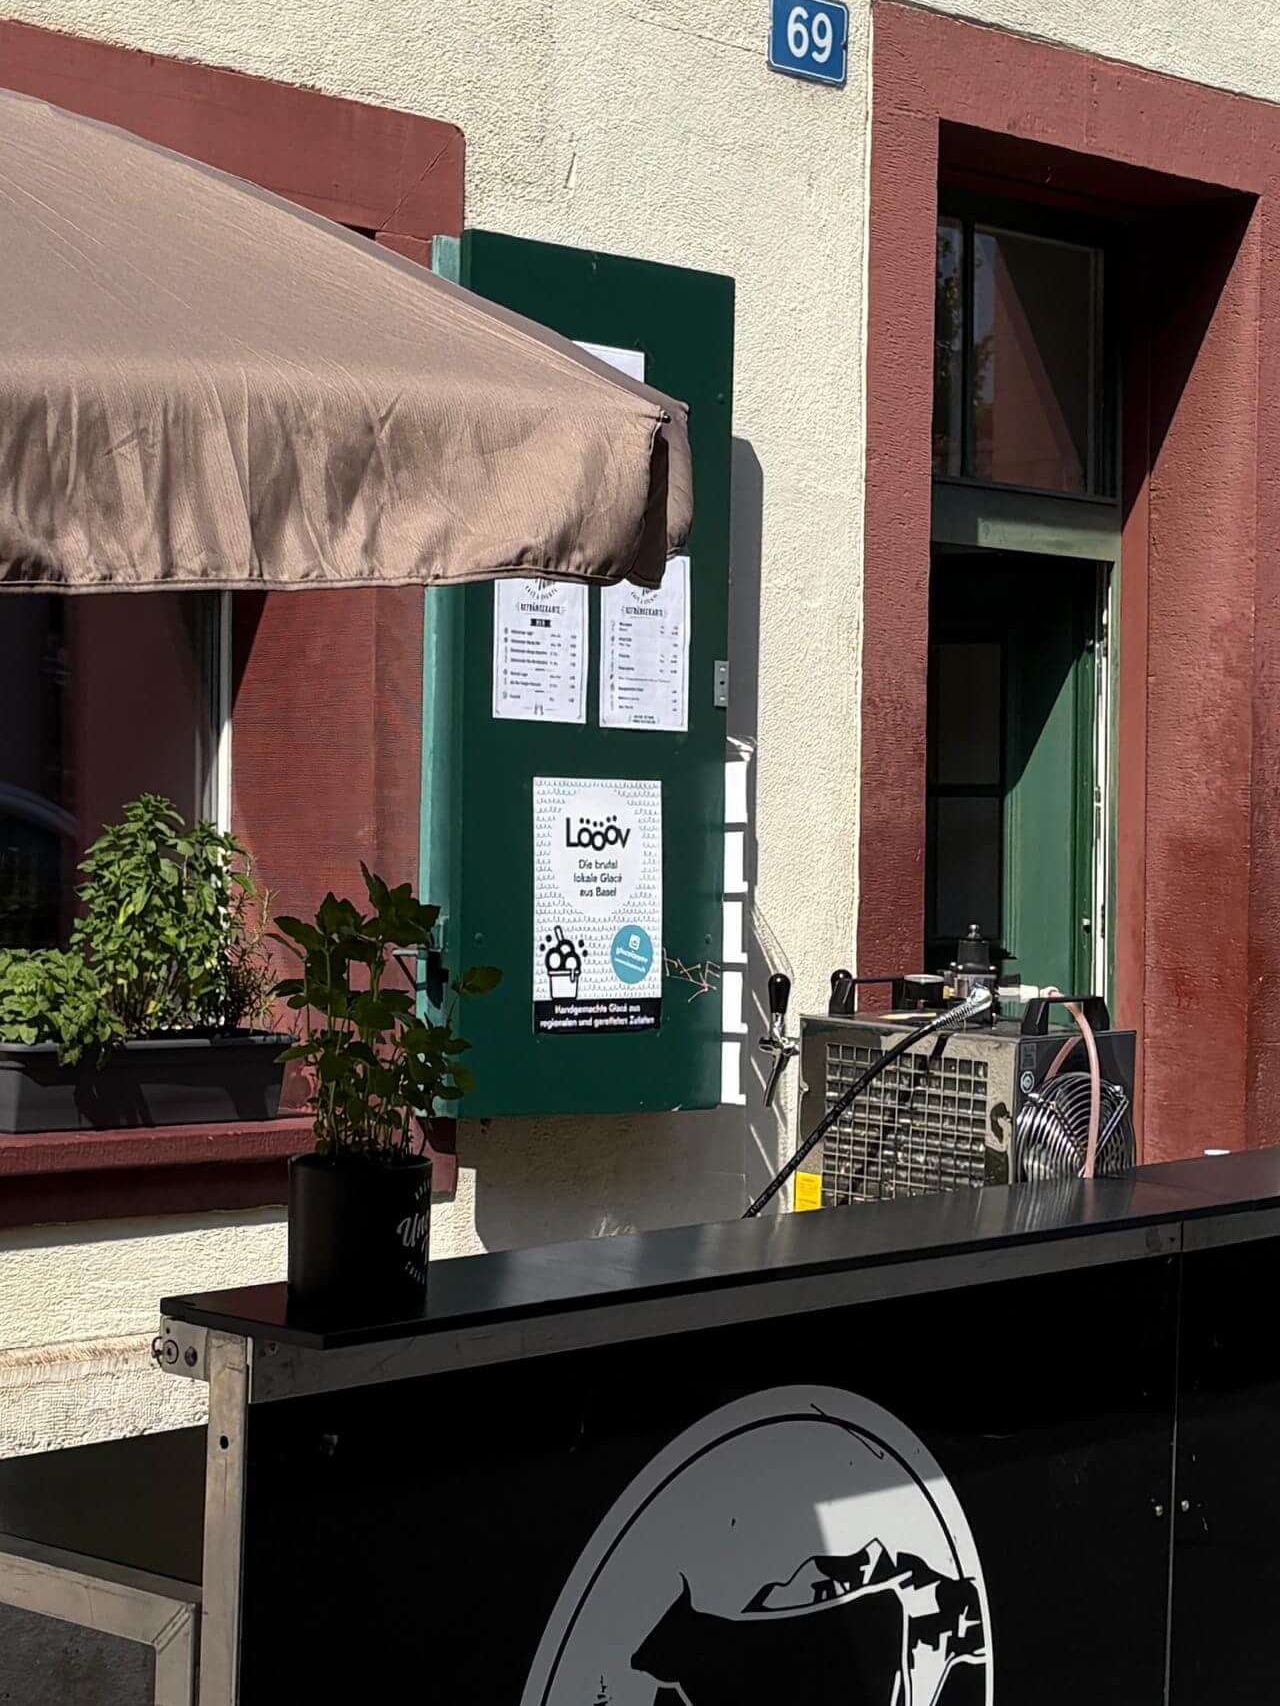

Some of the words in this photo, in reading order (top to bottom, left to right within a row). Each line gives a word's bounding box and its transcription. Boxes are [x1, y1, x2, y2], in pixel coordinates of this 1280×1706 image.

[787, 6, 833, 63] 69
[578, 859, 593, 869] Die
[595, 859, 618, 869] brutal
[573, 873, 597, 883] lokale
[579, 888, 593, 897] aus
[595, 887, 617, 897] Basel
